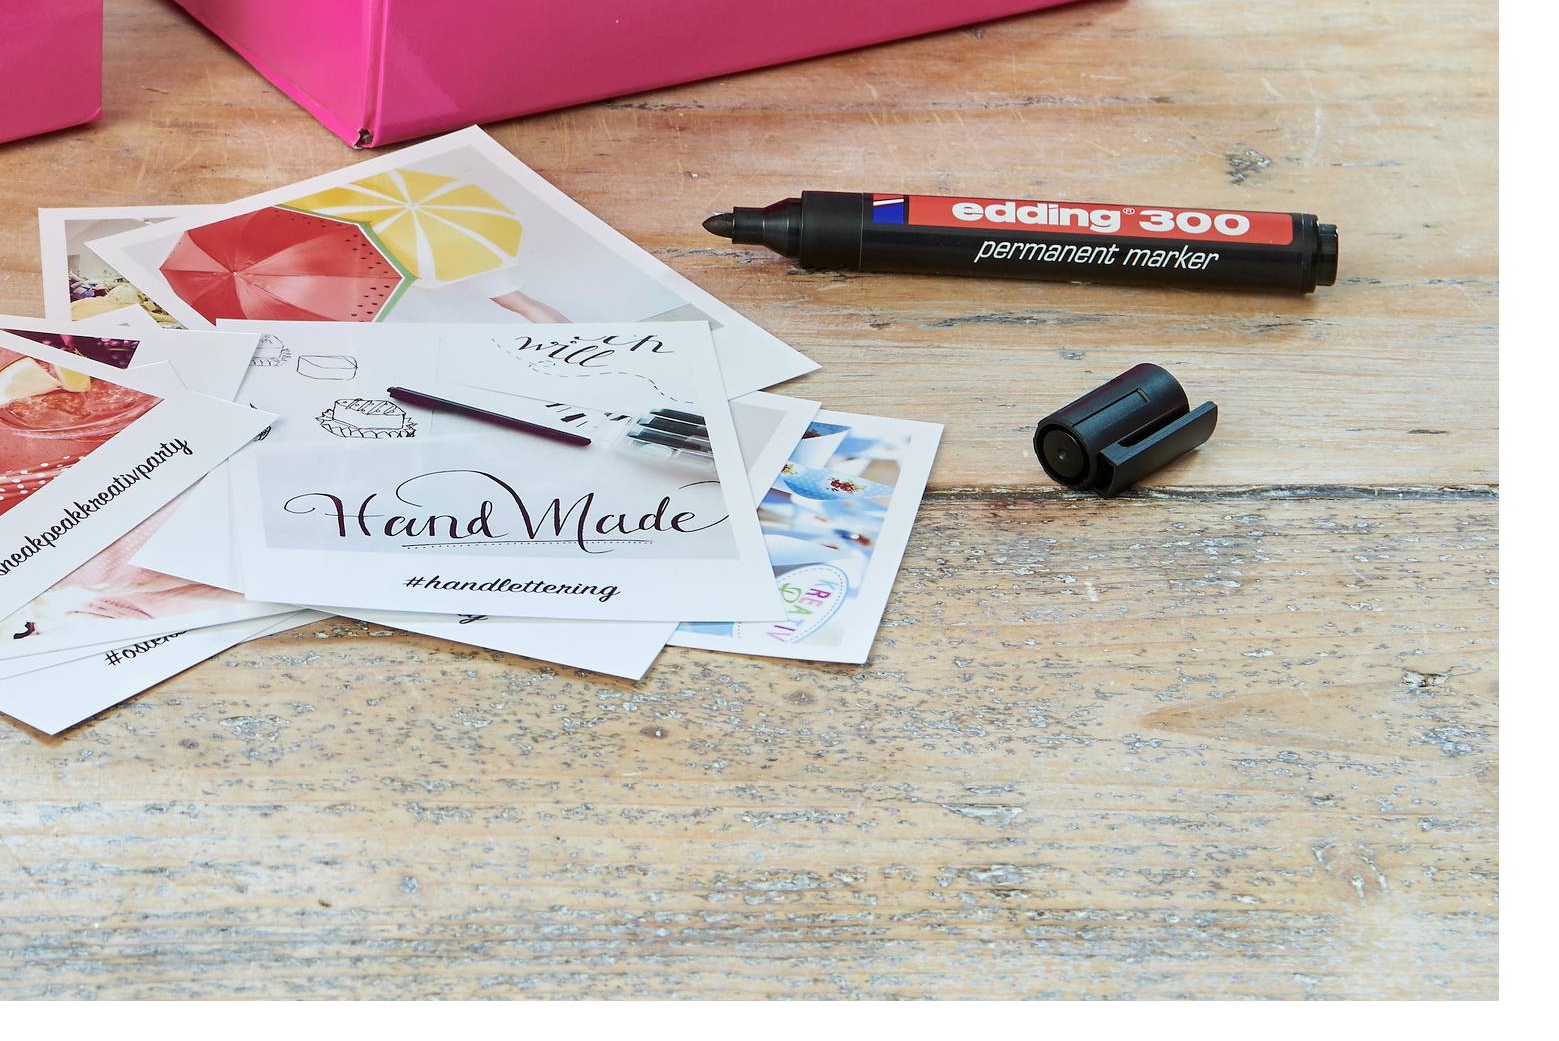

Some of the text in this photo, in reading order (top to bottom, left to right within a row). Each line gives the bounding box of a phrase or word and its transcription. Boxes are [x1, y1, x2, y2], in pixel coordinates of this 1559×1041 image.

[1139, 211, 1251, 237] 300
[974, 238, 1220, 271] permanent marker
[515, 335, 615, 367] will
[284, 470, 730, 553] Hand Made
[403, 575, 622, 604] #handlettering
